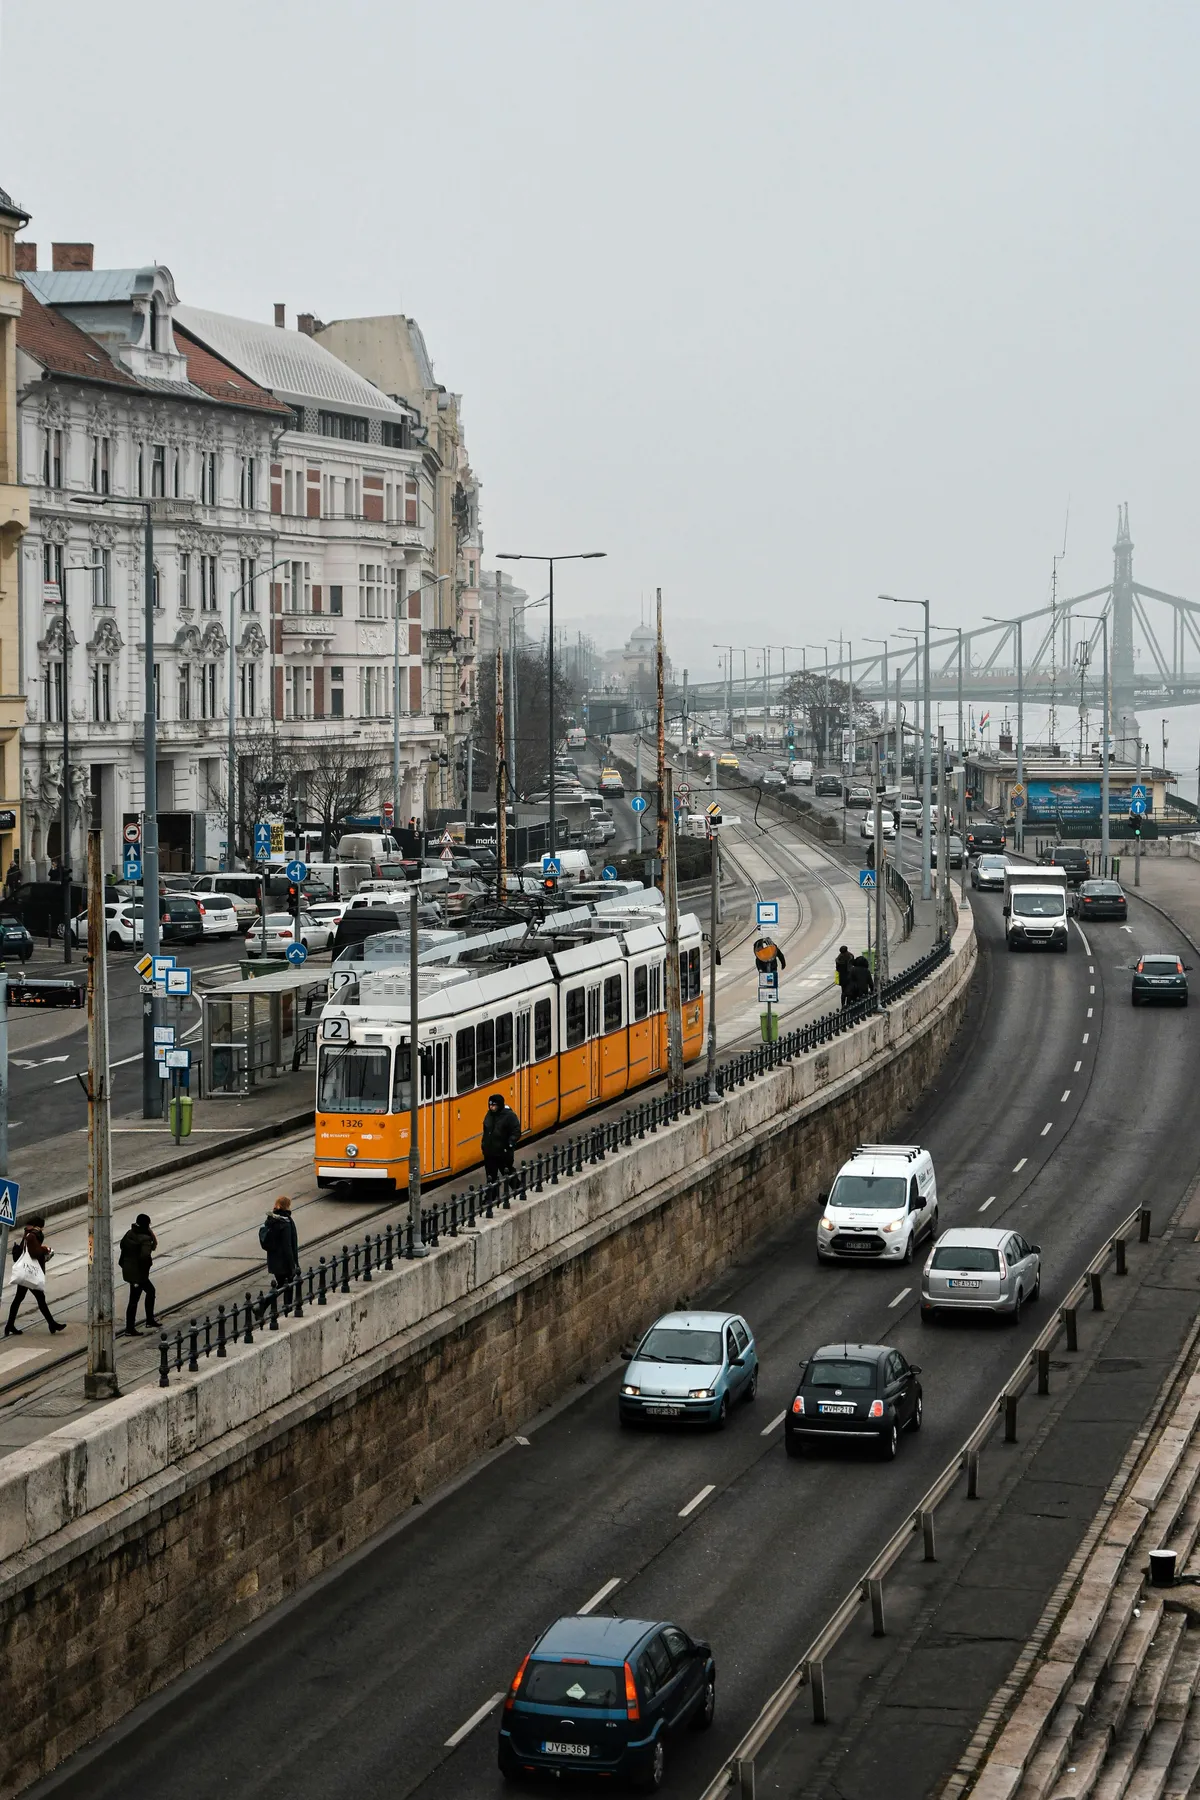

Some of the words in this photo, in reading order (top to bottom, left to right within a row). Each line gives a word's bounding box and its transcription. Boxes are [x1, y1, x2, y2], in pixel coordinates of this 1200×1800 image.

[127, 863, 138, 878] P
[340, 974, 351, 987] 2
[330, 1021, 342, 1037] 2
[341, 1119, 363, 1128] 1326
[547, 1742, 588, 1755] JYB-365
